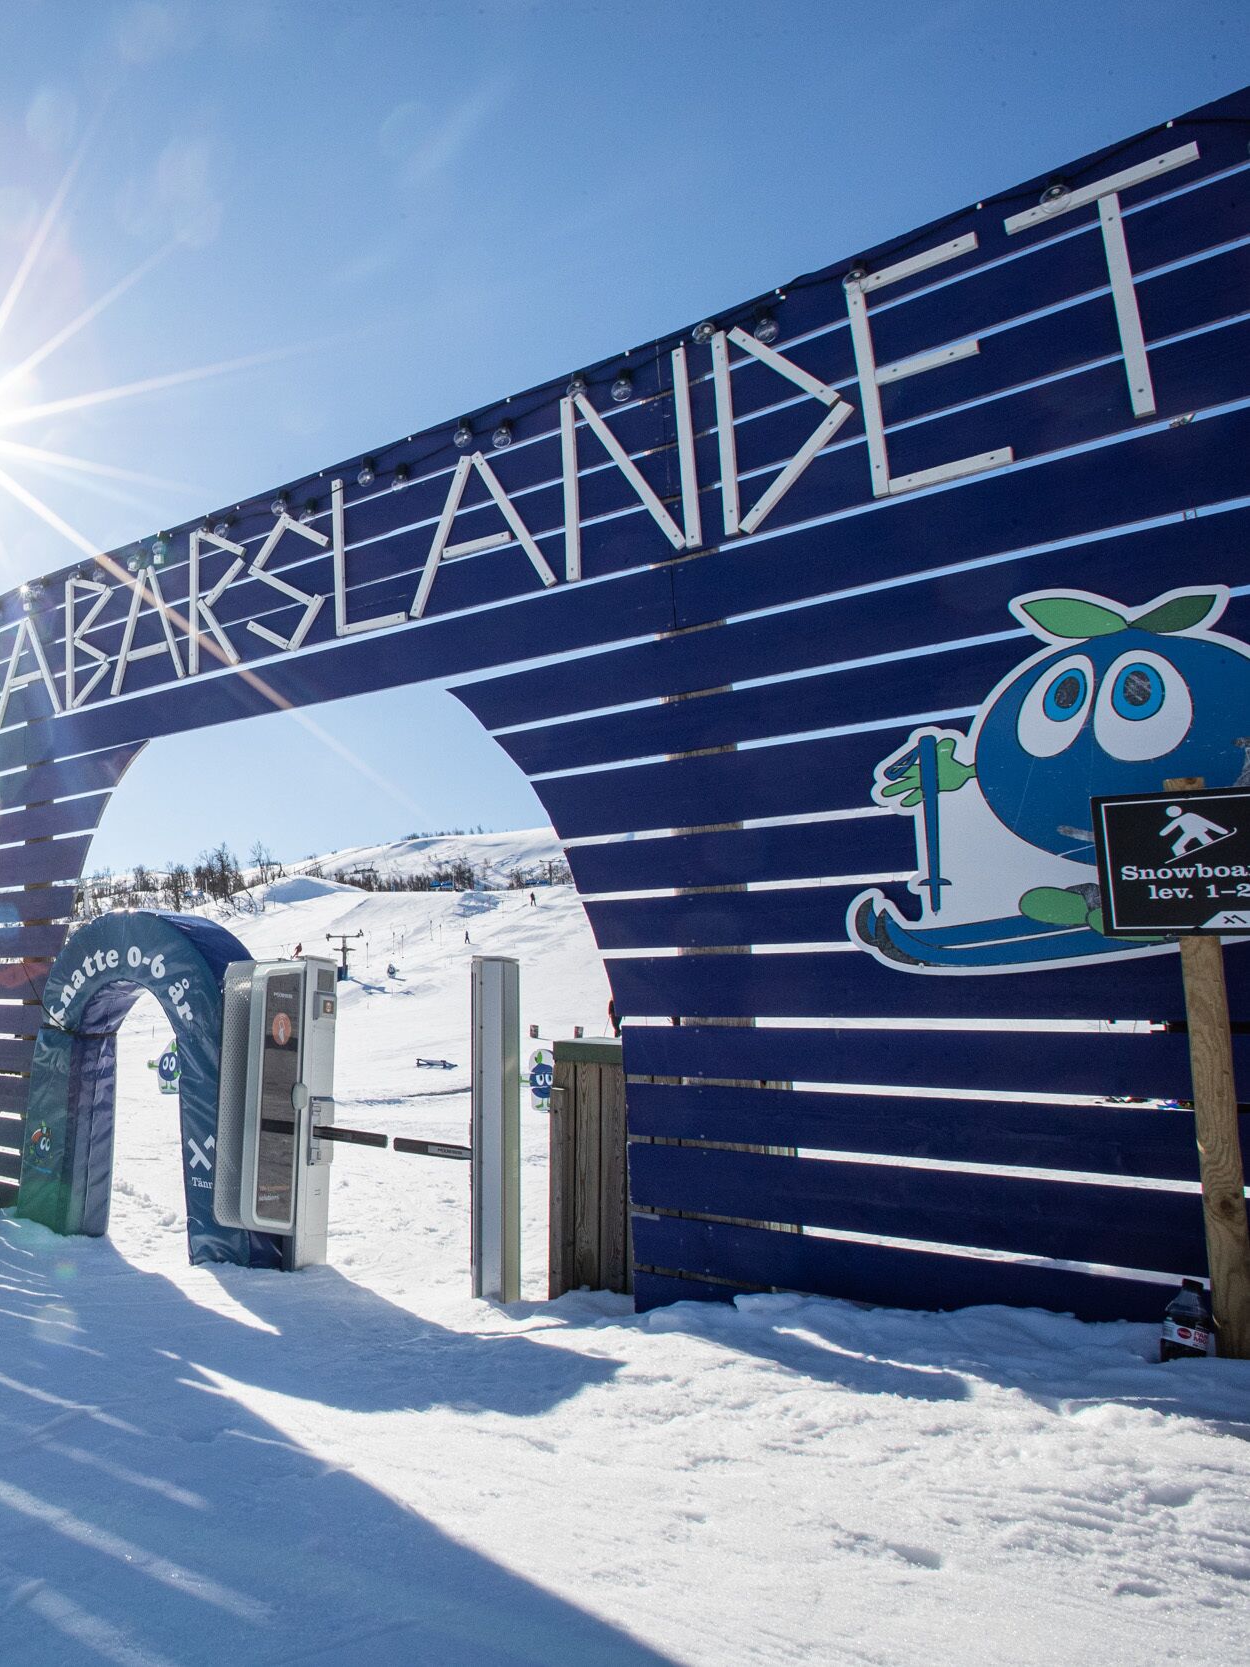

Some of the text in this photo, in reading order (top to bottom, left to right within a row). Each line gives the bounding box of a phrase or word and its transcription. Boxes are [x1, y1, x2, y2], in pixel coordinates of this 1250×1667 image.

[1120, 863, 1250, 880] Snowboa
[1148, 885, 1194, 899] lev.
[127, 946, 166, 979] 0-6
[168, 978, 193, 1021] år
